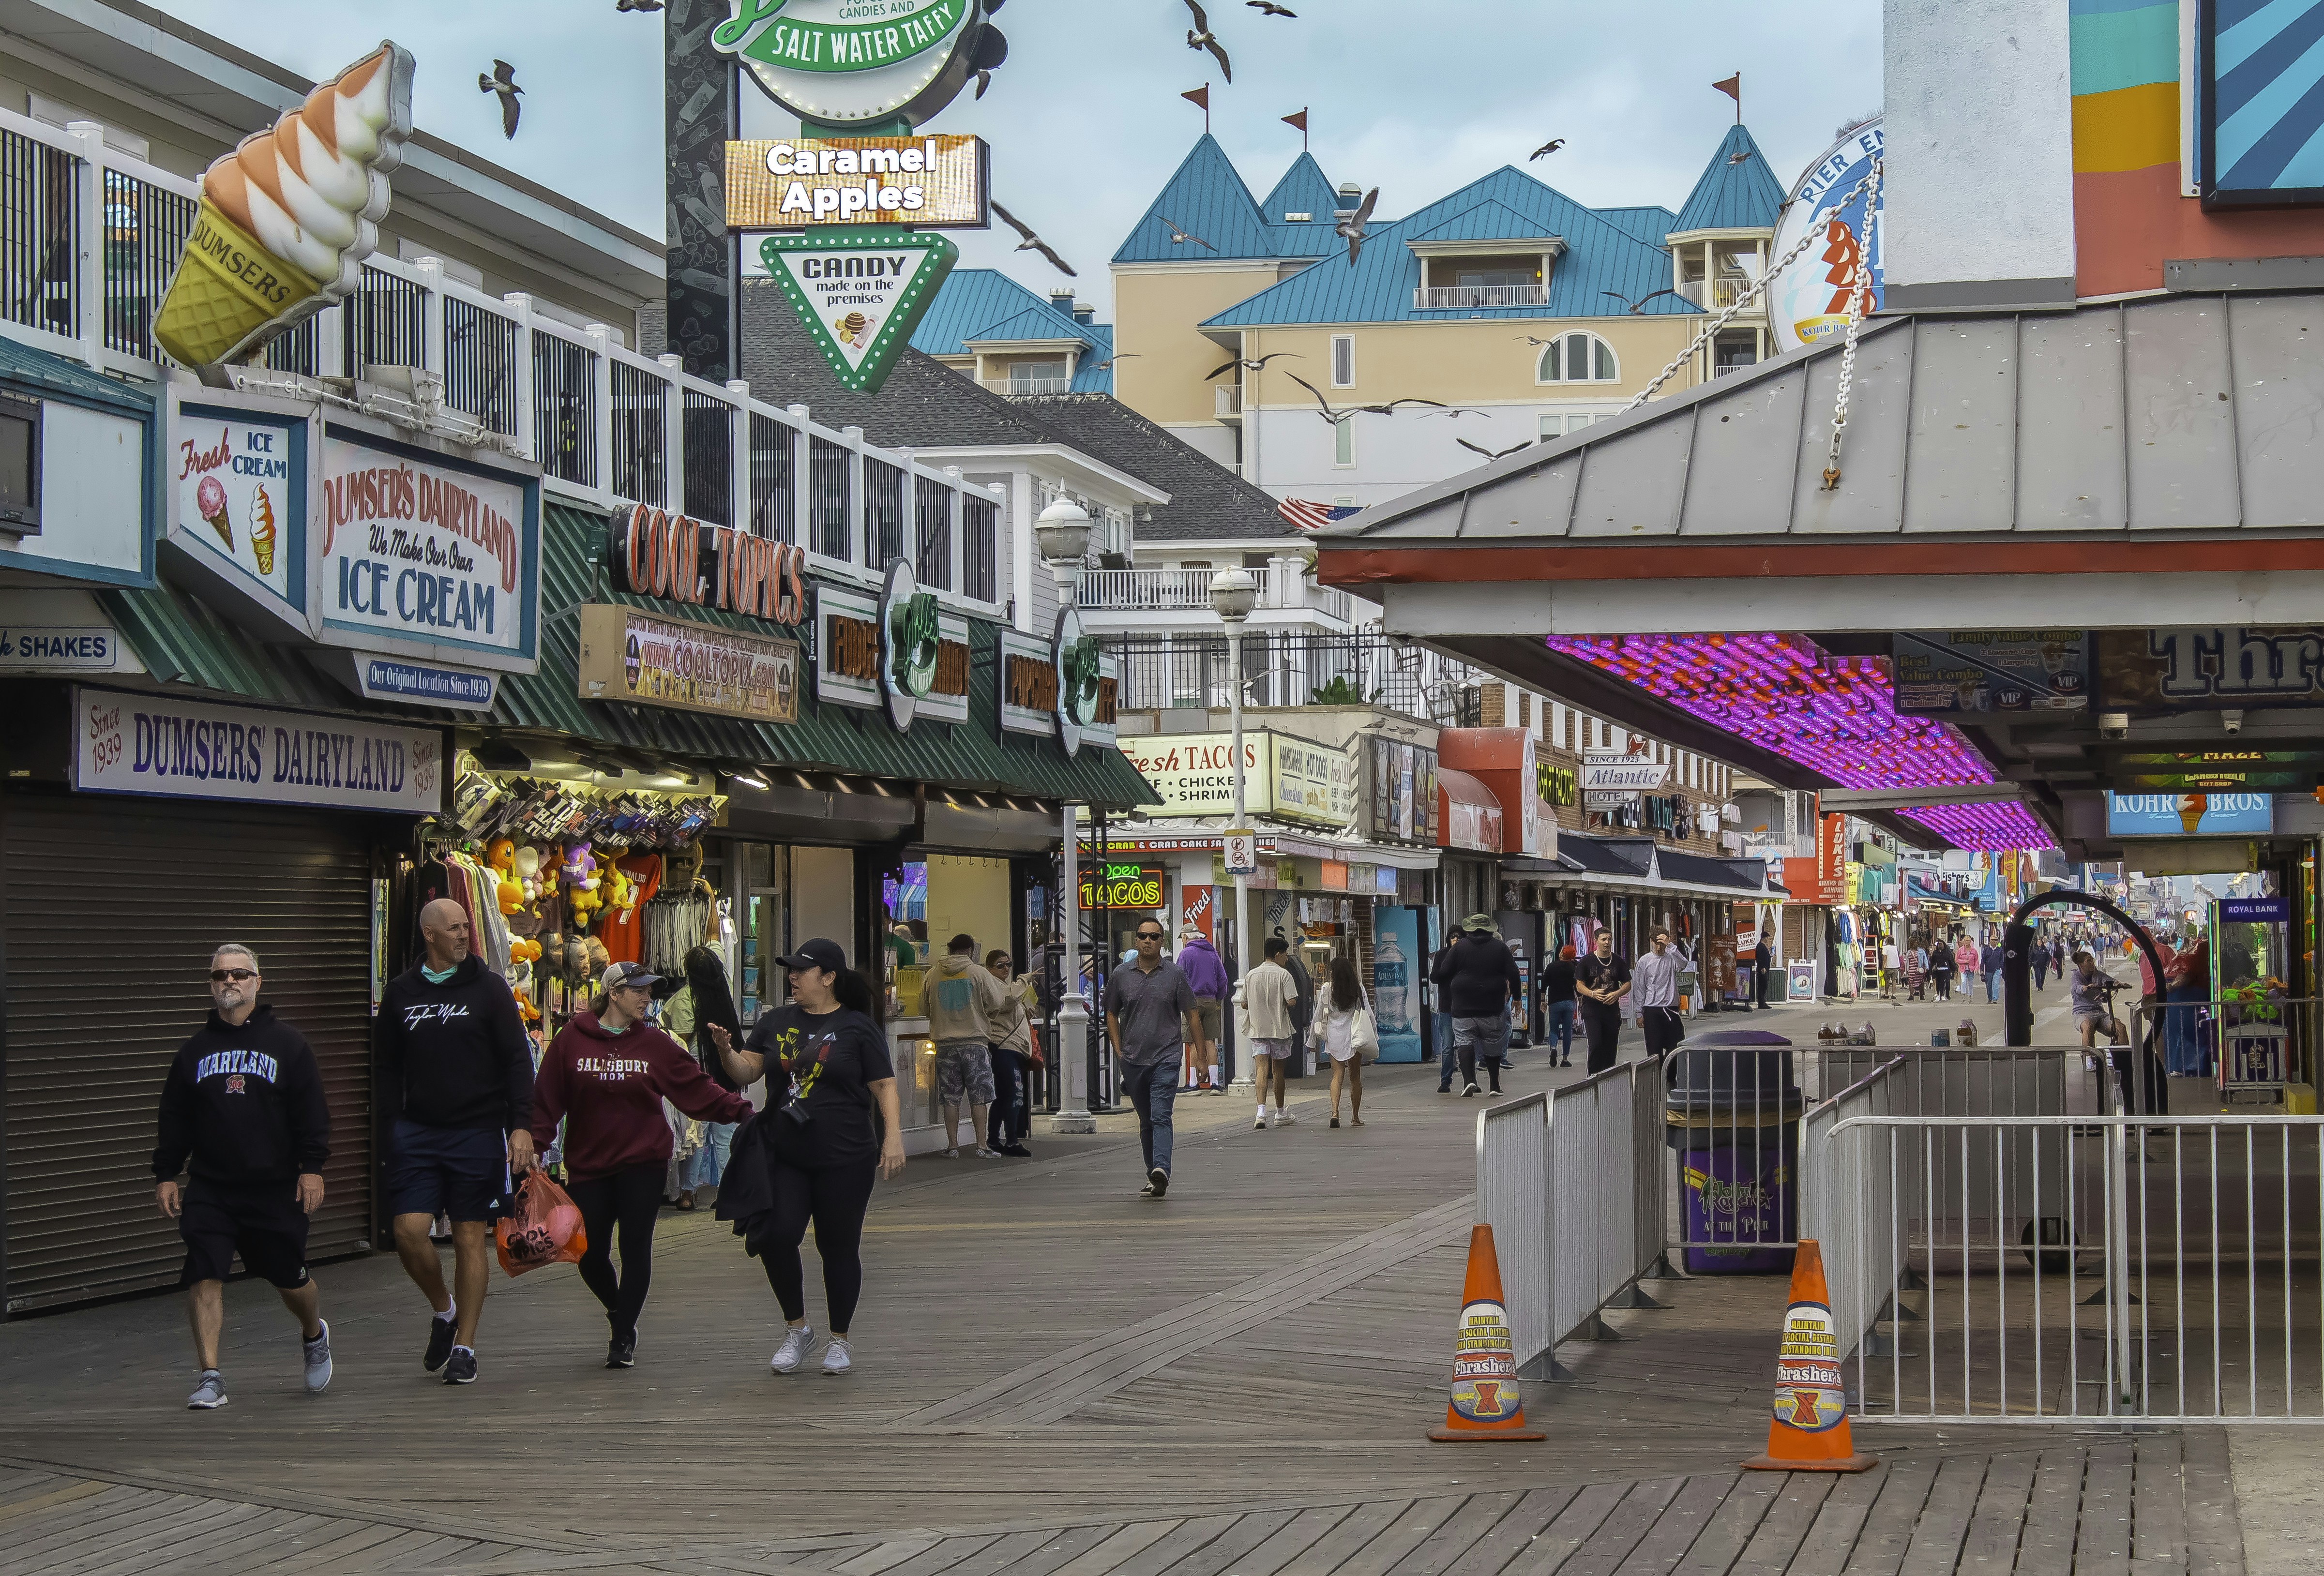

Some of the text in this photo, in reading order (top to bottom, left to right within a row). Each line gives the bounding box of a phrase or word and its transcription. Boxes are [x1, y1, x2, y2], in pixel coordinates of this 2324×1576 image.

[839, 4, 886, 19] CANDIES
[890, 1, 915, 14] AND
[772, 2, 953, 63] SALT WATER TAFFY
[766, 140, 936, 175] Caramel
[1800, 153, 1849, 204] PIER
[780, 179, 924, 220] Apples
[192, 219, 290, 303] DUMSERS
[803, 256, 906, 279] CANDY
[816, 278, 894, 292] made on the
[827, 293, 883, 307] premises
[1802, 325, 1830, 337] KOHR
[180, 427, 272, 480] Fresh ICE
[232, 455, 287, 479] CREAM
[323, 462, 516, 594] DUMSER'S DAIRYLAND
[368, 524, 473, 572] We Make Our Own
[627, 503, 805, 626] COOL TOPICS
[339, 555, 494, 634] ICE CREAM
[19, 636, 107, 658] SHAKES
[2155, 628, 2324, 690] Thr
[371, 665, 488, 697] Our Original Location Since 1939
[1899, 669, 1983, 681] Value Combo
[2057, 676, 2078, 687] VIP
[2000, 692, 2021, 703] VIP
[91, 705, 120, 740] Since
[272, 727, 405, 793] DAIRYLAND
[413, 740, 434, 770] Since
[92, 733, 434, 799] 1939 1939
[1306, 752, 1315, 777] HOT
[1316, 754, 1327, 780] DOGS
[1588, 768, 1659, 785] Atlantic
[1179, 789, 1235, 801] SHRIM
[1587, 791, 1629, 802] HOTEL
[2114, 795, 2175, 813] KOHR
[1149, 841, 1178, 849] CRAB
[1100, 863, 1141, 880] Open
[1082, 881, 1160, 906] TACOS
[1184, 888, 1211, 925] Fried
[2228, 905, 2278, 914] ROYAL BANK
[196, 1050, 278, 1084] MARYLAND
[577, 1057, 649, 1074] SALISBURY
[1468, 1316, 1500, 1326] MAINTAIN
[1791, 1320, 1825, 1331] MAINTAIN
[1465, 1328, 1488, 1337] SOCIAL
[1489, 1327, 1510, 1338] DISTANC
[1787, 1332, 1837, 1344] SOCIAL DISTANC
[1467, 1338, 1498, 1350] STANDING
[1788, 1344, 1822, 1355] STANDING
[1455, 1357, 1516, 1375] Thrasher's
[1777, 1365, 1842, 1386] Thrasher's
